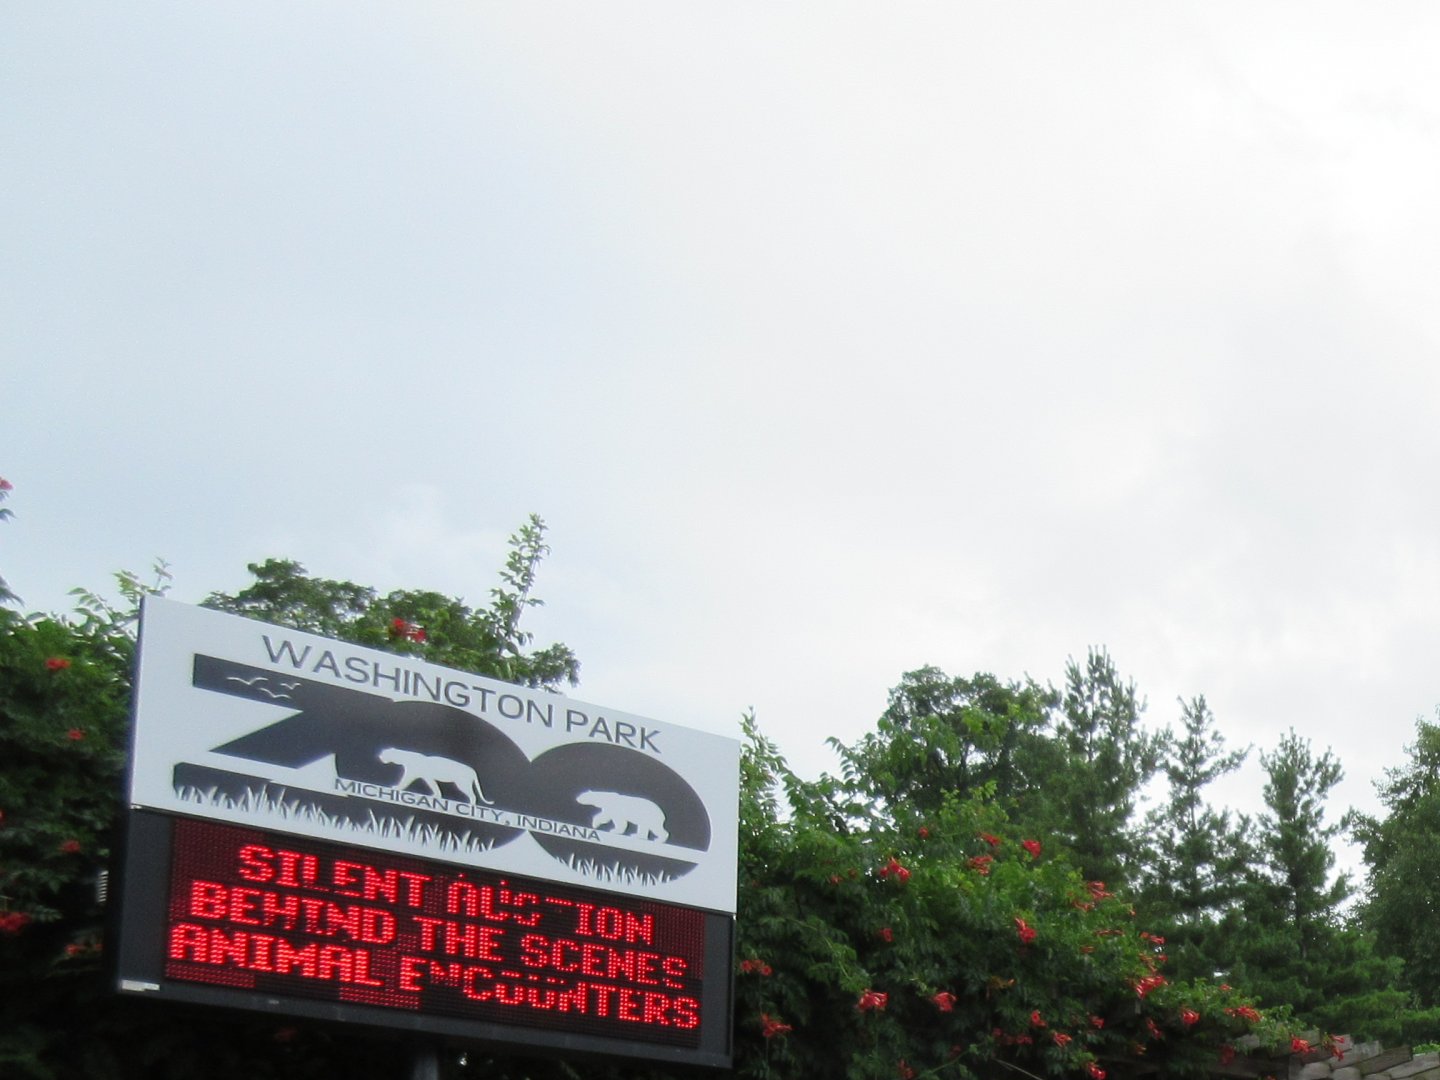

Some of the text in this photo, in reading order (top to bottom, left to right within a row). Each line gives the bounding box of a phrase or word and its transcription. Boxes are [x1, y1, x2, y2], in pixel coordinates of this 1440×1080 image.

[261, 635, 662, 754] WASHINGTON PARK
[334, 778, 601, 841] MICHIGAN CITY, INDIANA
[190, 879, 688, 990] BEHIND THE SCENES
[239, 844, 655, 945] SILENT AUCION
[170, 922, 385, 987] ANIMAL
